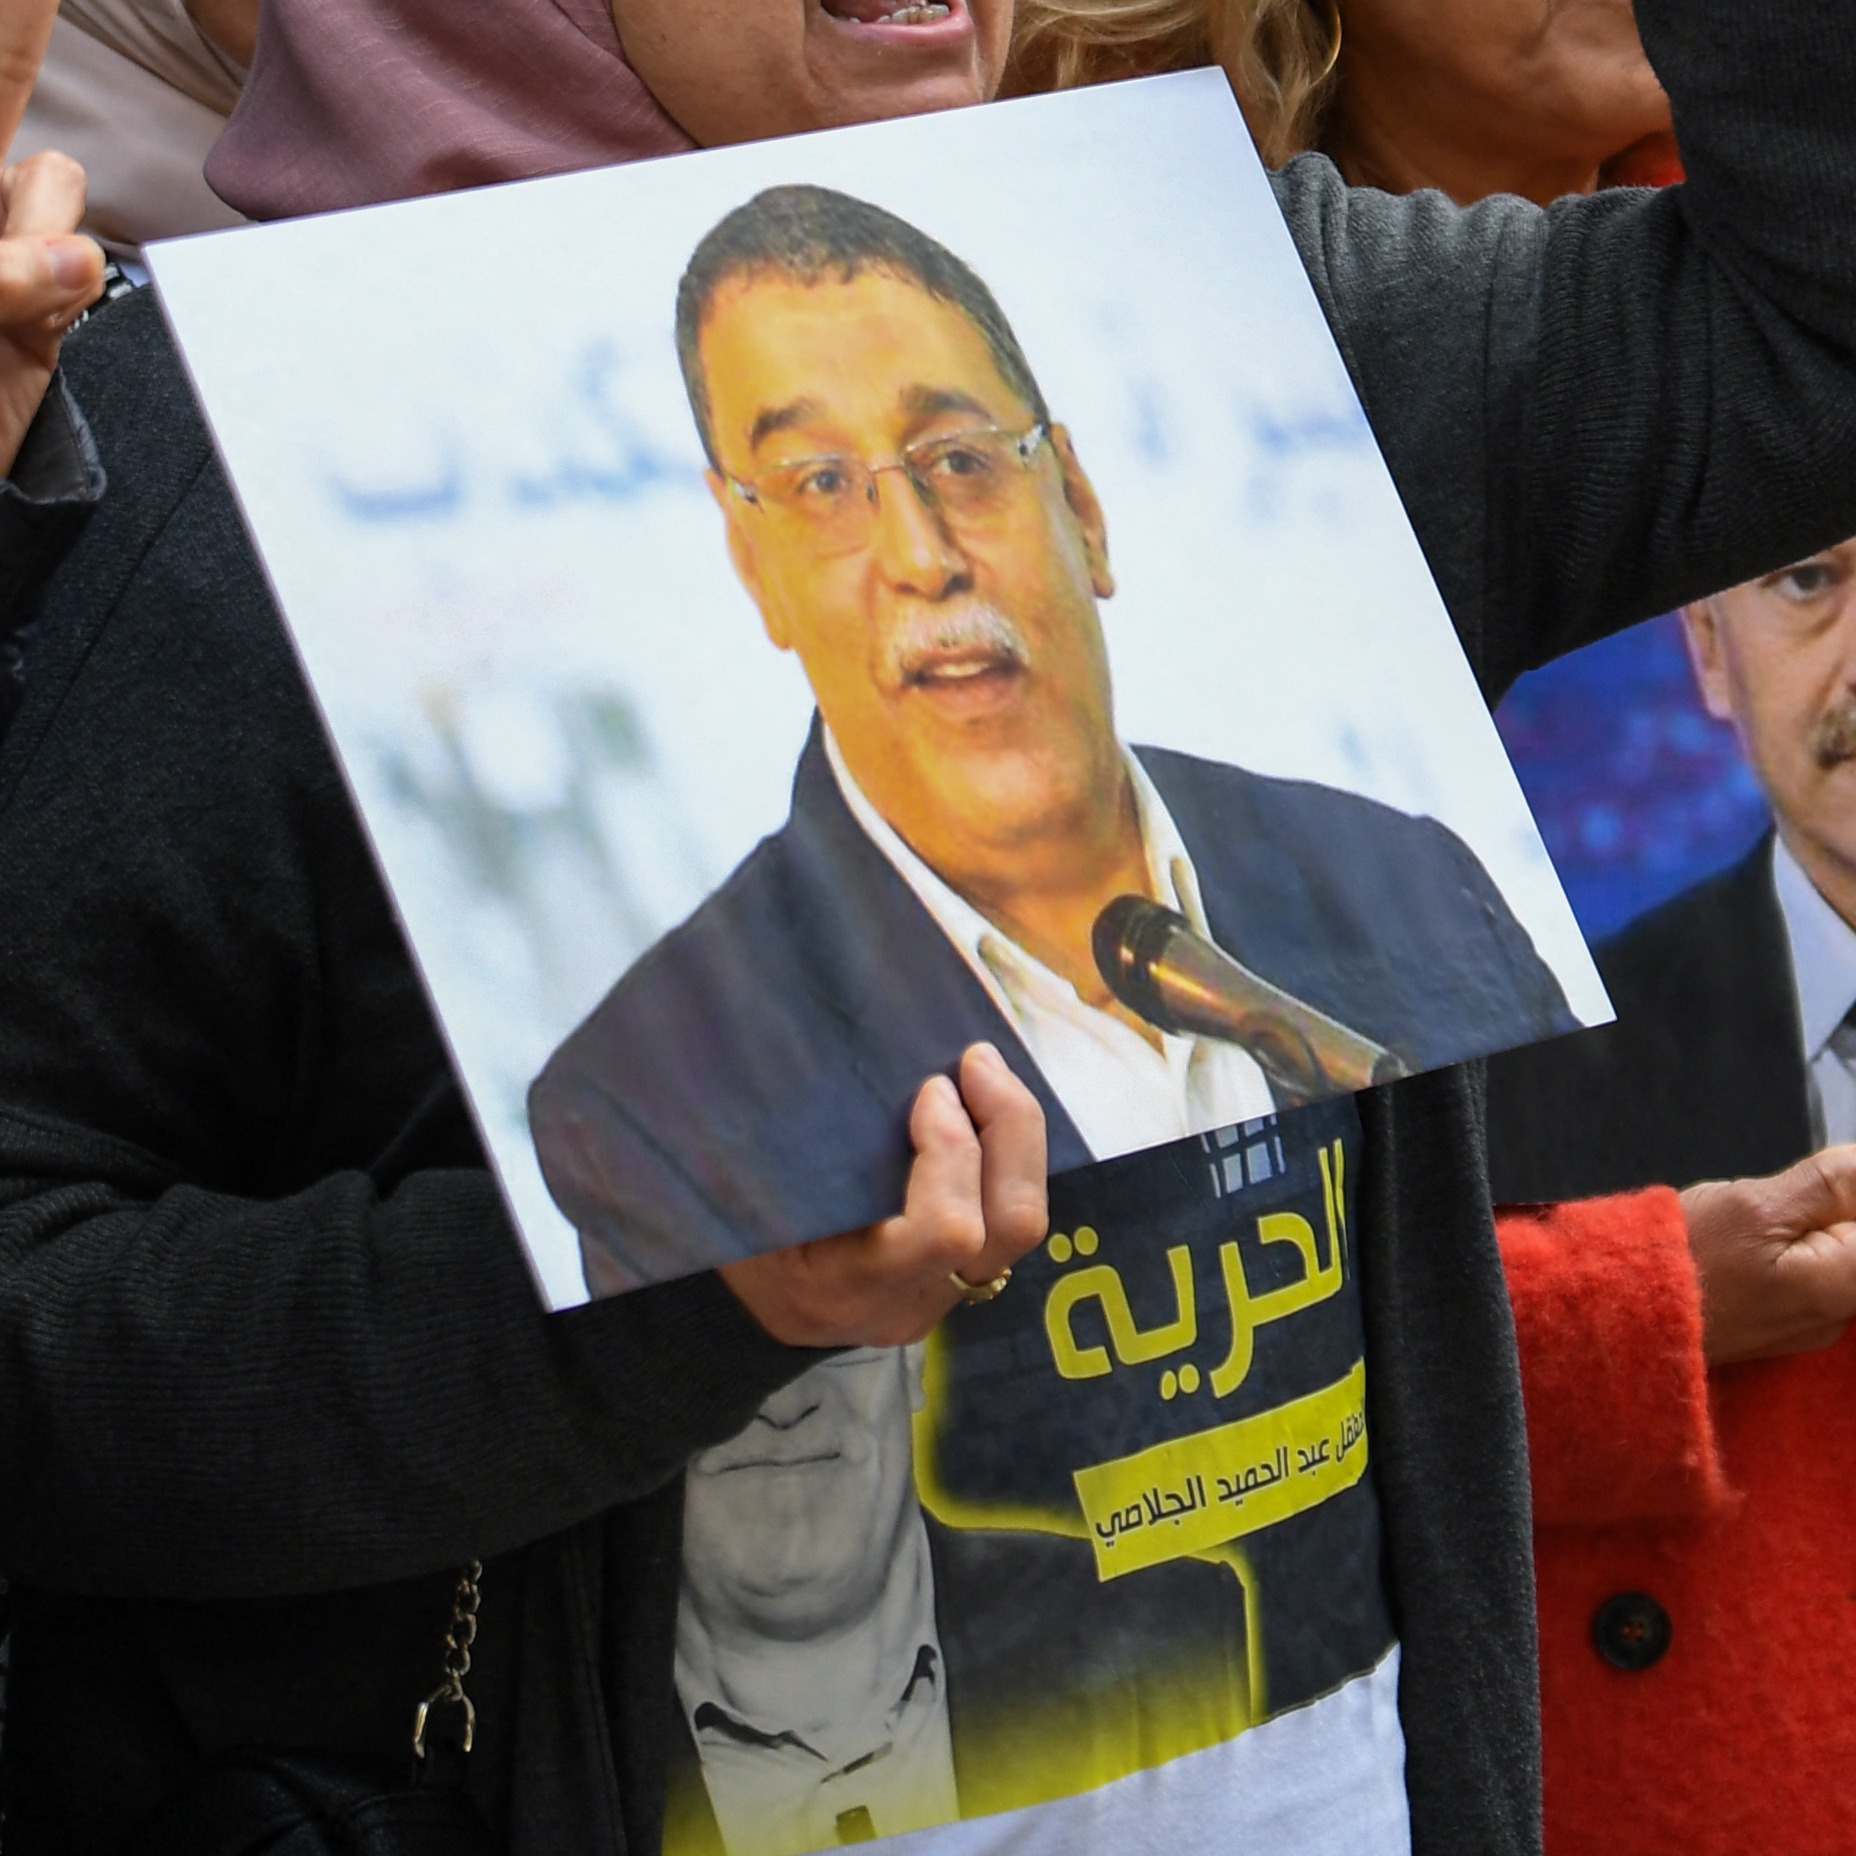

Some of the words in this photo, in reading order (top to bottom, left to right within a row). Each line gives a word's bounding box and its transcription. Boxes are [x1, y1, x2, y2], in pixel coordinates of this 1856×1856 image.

[1045, 1138, 1347, 1401] الحرية
[1216, 1446, 1289, 1505] الحميد
[1297, 1439, 1330, 1475] عبد
[1095, 1475, 1207, 1547] الجلاصي
